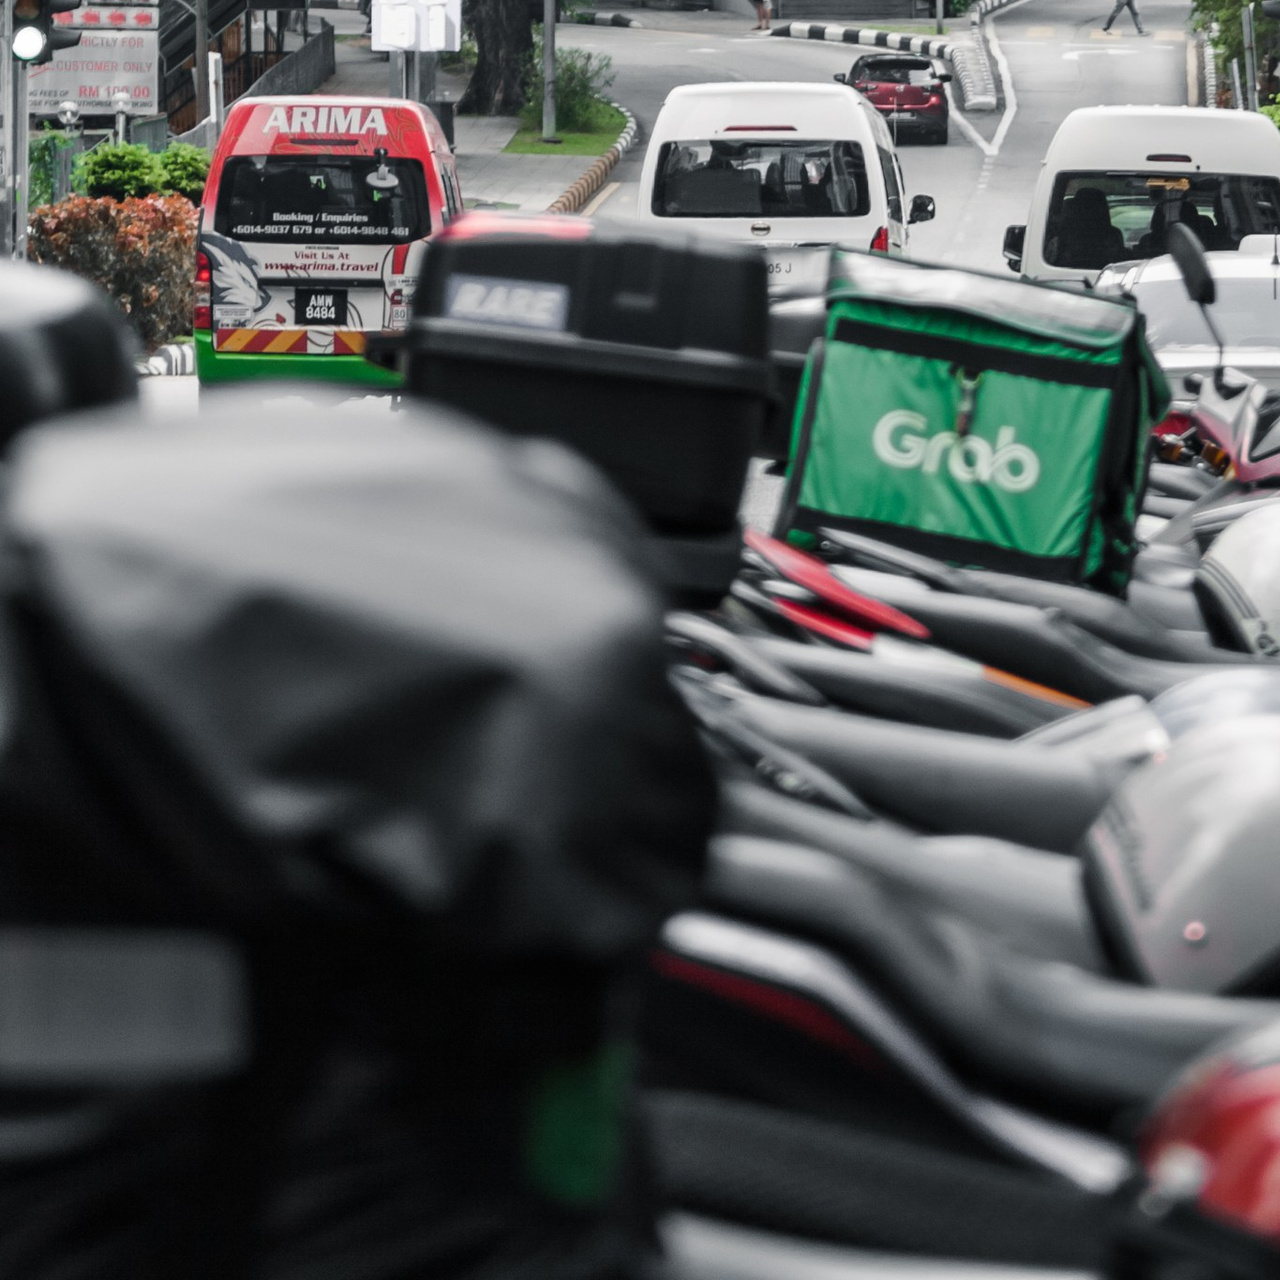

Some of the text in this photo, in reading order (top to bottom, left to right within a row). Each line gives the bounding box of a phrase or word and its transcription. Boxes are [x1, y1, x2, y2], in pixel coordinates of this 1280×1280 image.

[121, 36, 144, 48] FOR
[123, 62, 152, 73] ONLY
[78, 86, 99, 98] RM
[262, 106, 388, 135] ARIMA
[273, 213, 313, 223] Booking
[321, 213, 368, 223] Enquiries
[232, 225, 289, 235] +6014-9037
[292, 226, 313, 235] 679
[314, 227, 326, 235] or
[294, 251, 350, 261] Visit Us At
[264, 261, 379, 273] www.arima.travel
[309, 295, 334, 307] AMW
[306, 306, 336, 319] 8484
[393, 309, 406, 319] 80
[873, 409, 1041, 494] Grab
